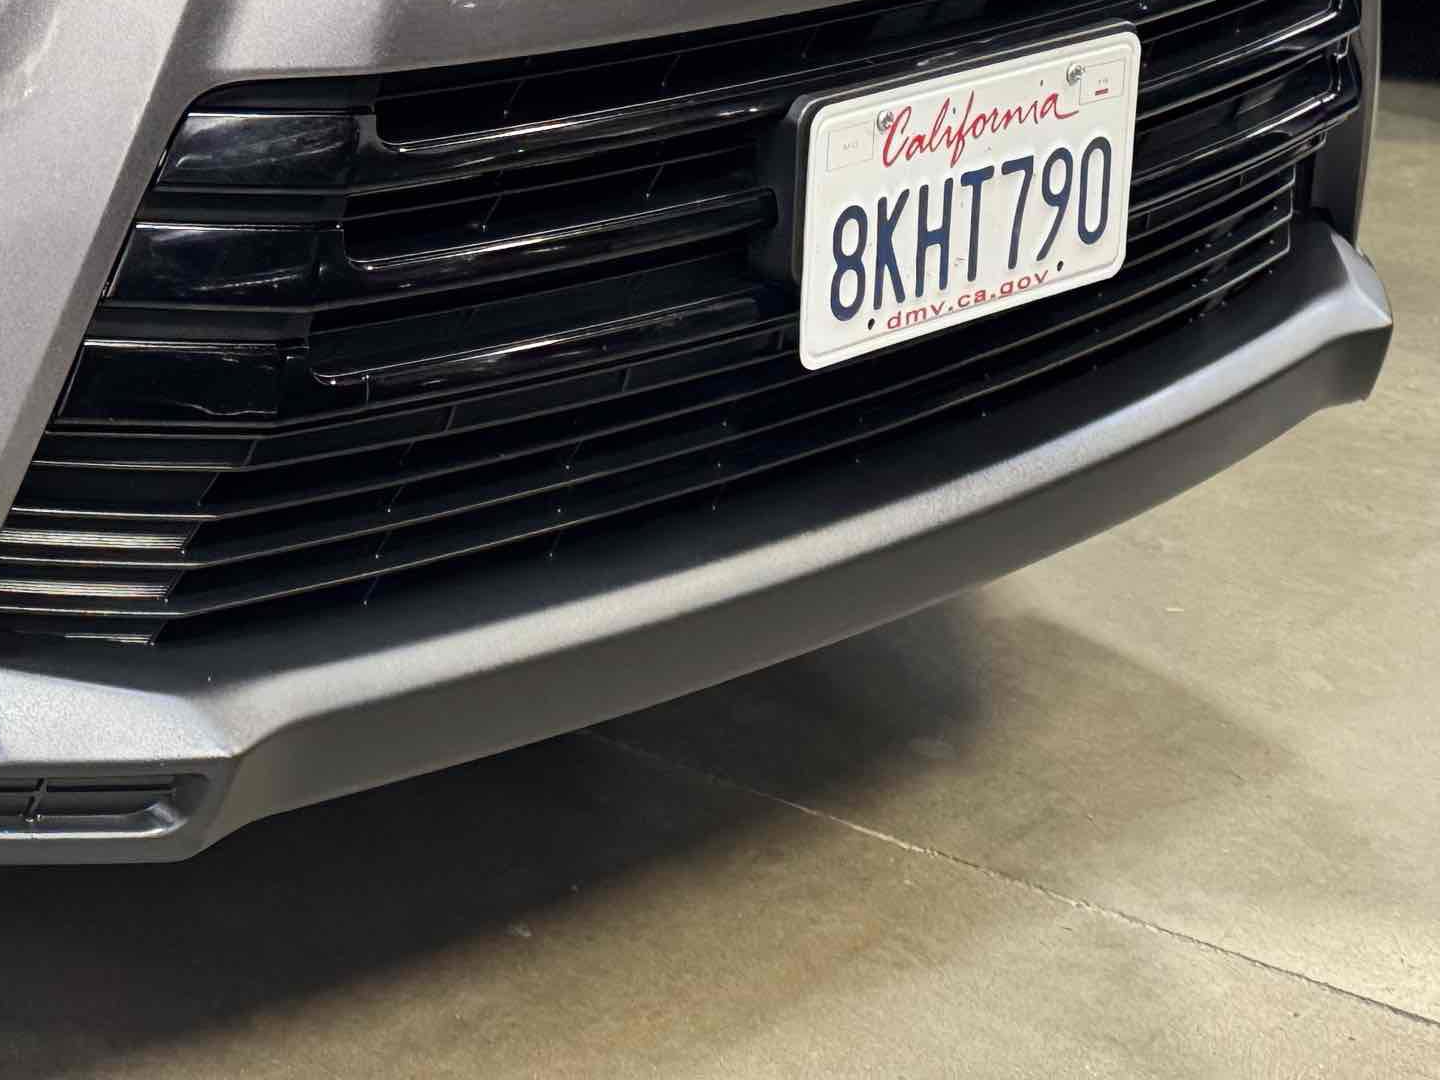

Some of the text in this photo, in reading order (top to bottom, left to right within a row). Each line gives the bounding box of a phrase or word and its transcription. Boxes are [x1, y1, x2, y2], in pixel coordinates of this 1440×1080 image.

[882, 82, 1080, 168] California
[830, 136, 1112, 322] 8KHT790
[887, 271, 1049, 329] dmv.ca.gov
